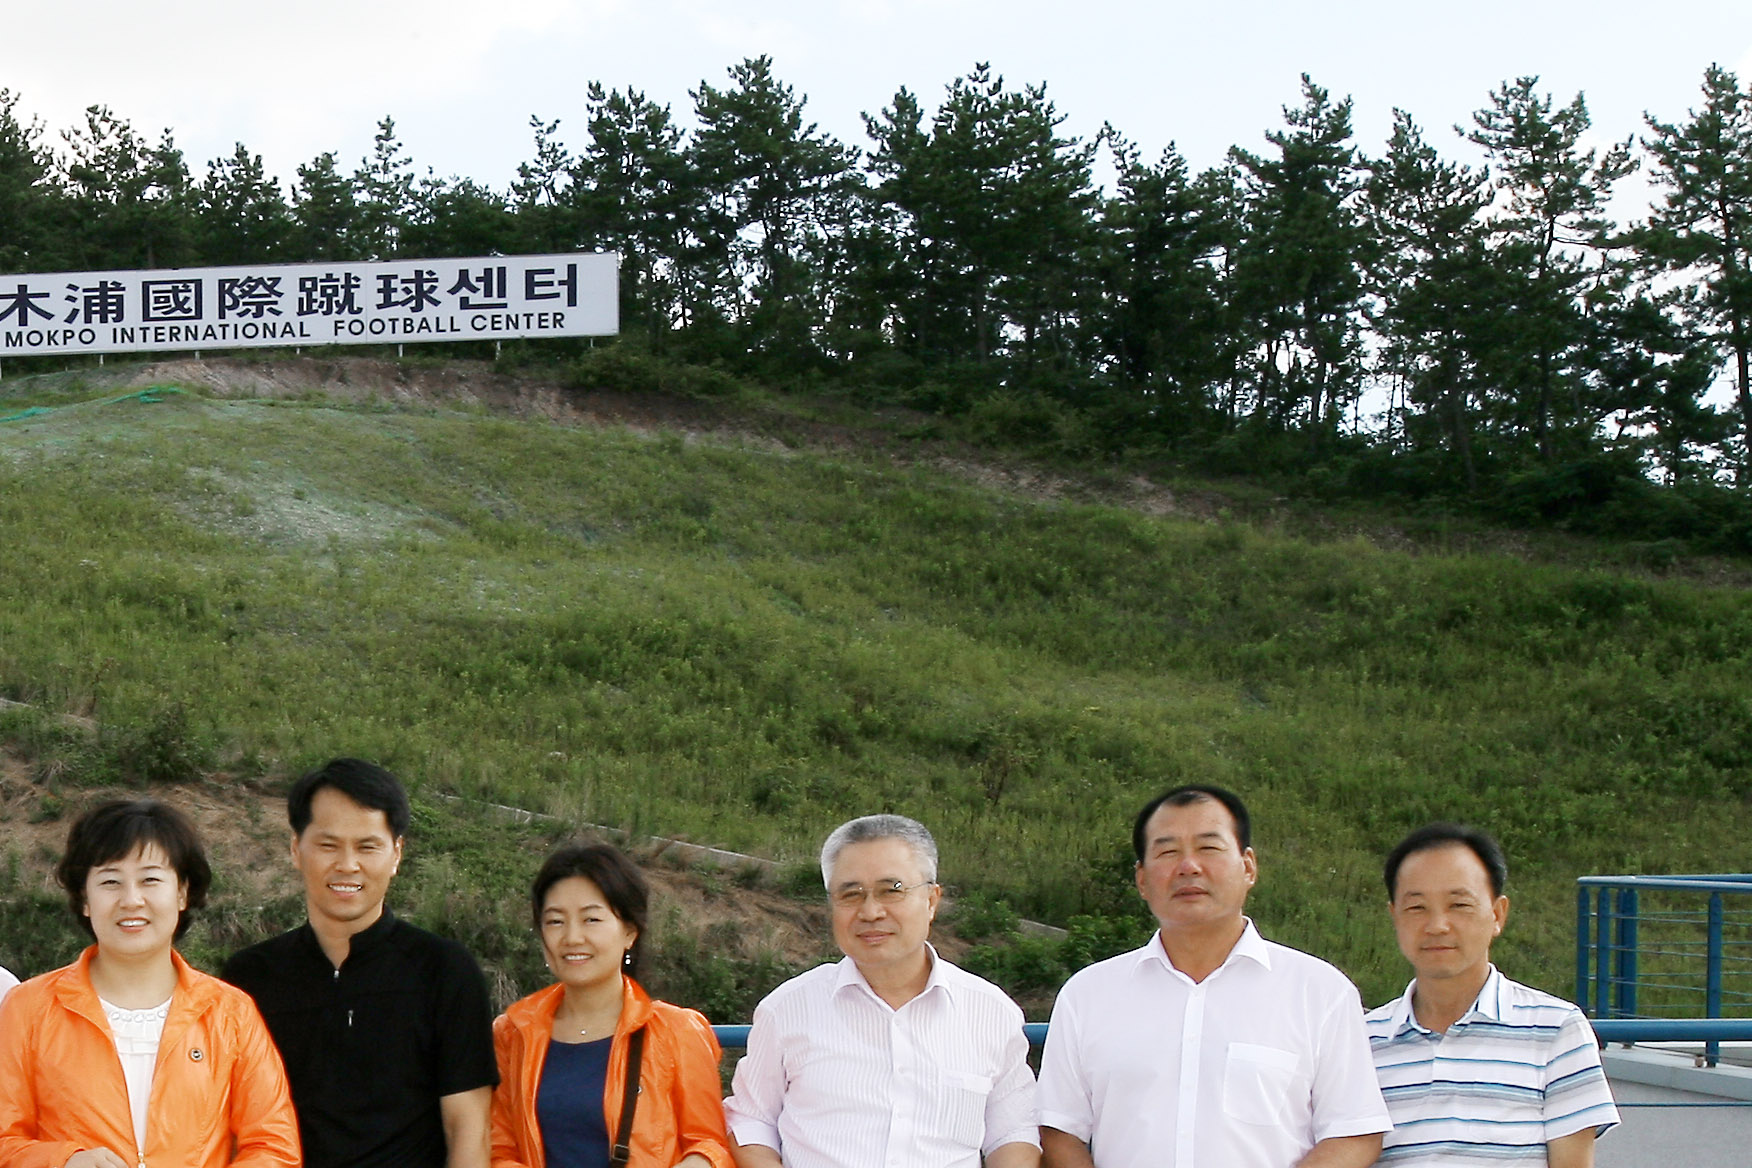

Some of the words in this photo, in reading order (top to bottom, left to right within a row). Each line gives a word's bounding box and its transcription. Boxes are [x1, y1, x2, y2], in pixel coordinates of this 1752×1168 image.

[5, 328, 96, 348] MOKPO
[112, 321, 311, 344] INTERNATIONAL
[334, 316, 461, 337] FOOTBALL
[470, 312, 565, 331] CENTER
